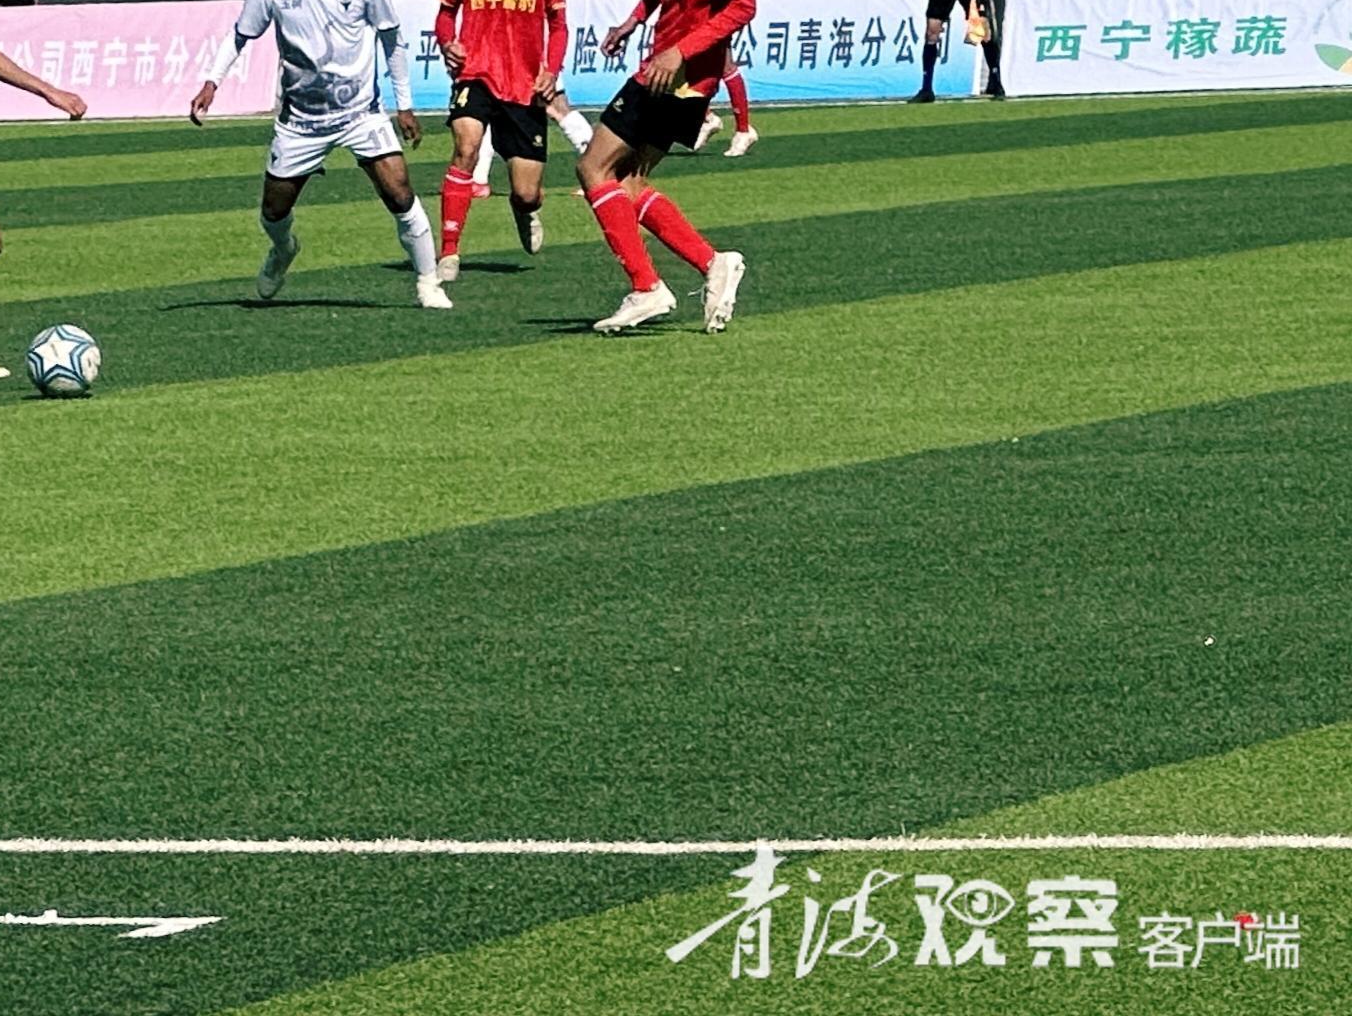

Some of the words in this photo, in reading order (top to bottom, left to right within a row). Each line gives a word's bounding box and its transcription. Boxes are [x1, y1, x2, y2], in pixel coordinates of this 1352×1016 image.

[1034, 15, 1288, 63] 西宁稼蔬
[367, 126, 392, 152] 11
